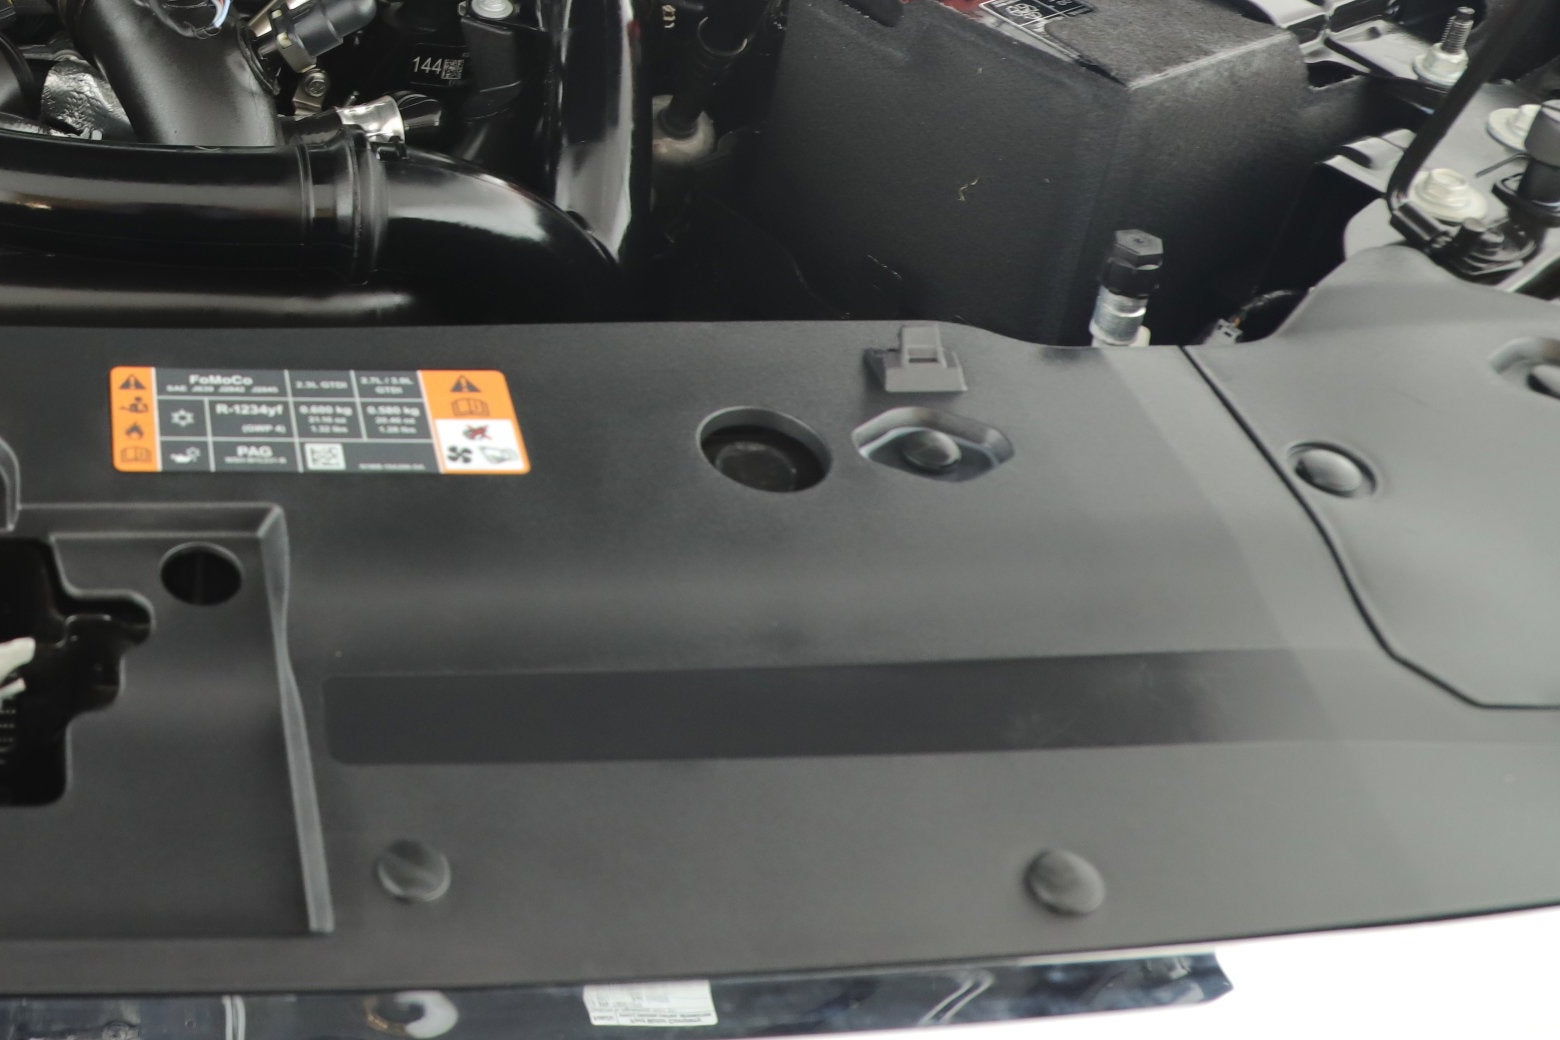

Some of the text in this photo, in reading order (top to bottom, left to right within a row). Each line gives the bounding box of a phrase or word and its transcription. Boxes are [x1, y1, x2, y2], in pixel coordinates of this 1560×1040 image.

[412, 56, 442, 74] 144
[188, 374, 253, 385] FoMoCo
[215, 403, 283, 417] R-1234yf
[335, 405, 353, 417] kg
[403, 405, 421, 417] kg
[236, 446, 274, 457] PAG
